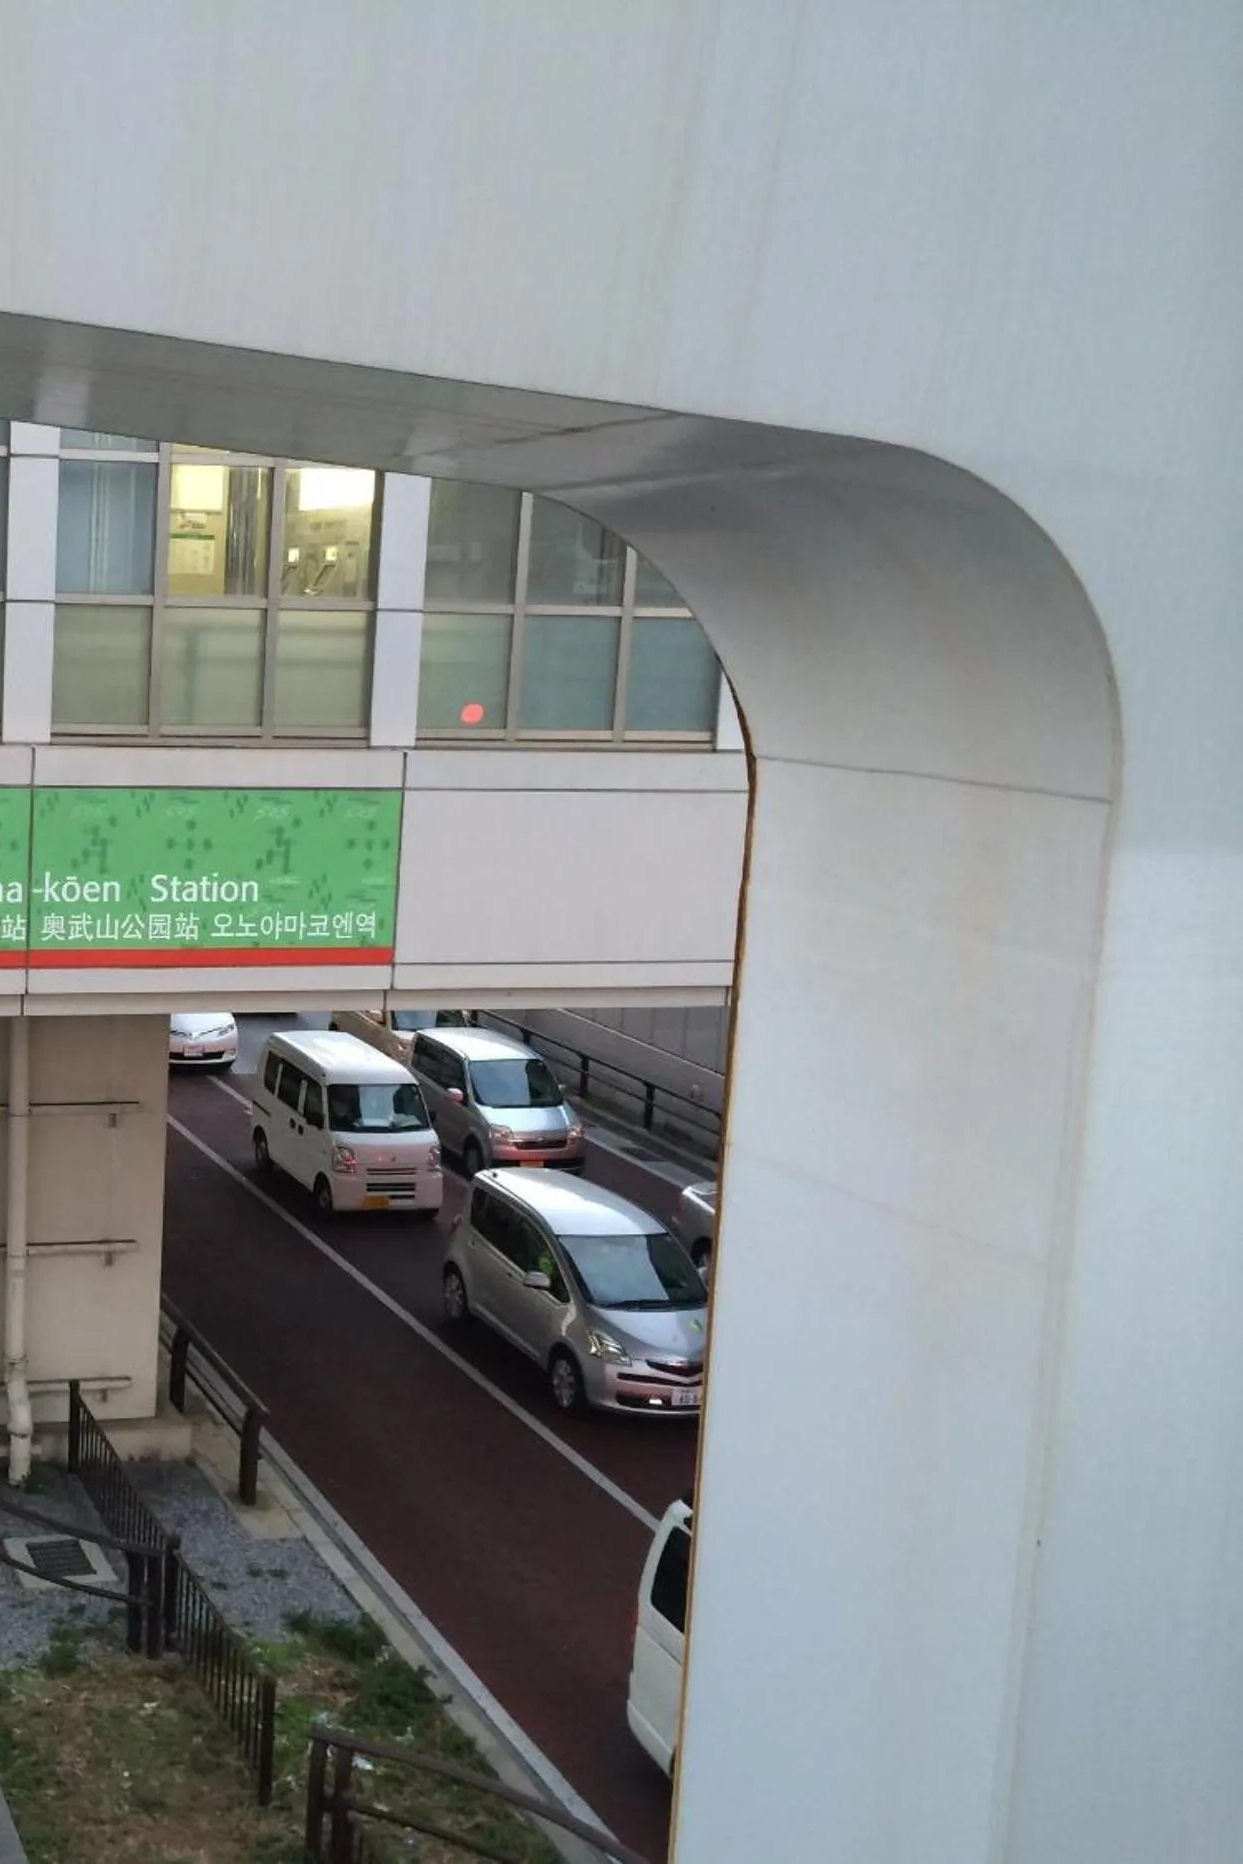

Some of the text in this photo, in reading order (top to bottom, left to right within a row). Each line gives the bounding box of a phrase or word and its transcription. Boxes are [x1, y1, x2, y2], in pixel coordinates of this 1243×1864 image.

[150, 872, 259, 903] Station
[40, 912, 200, 942] 奥武山公园站
[210, 911, 376, 940] 오노야마코엔역
